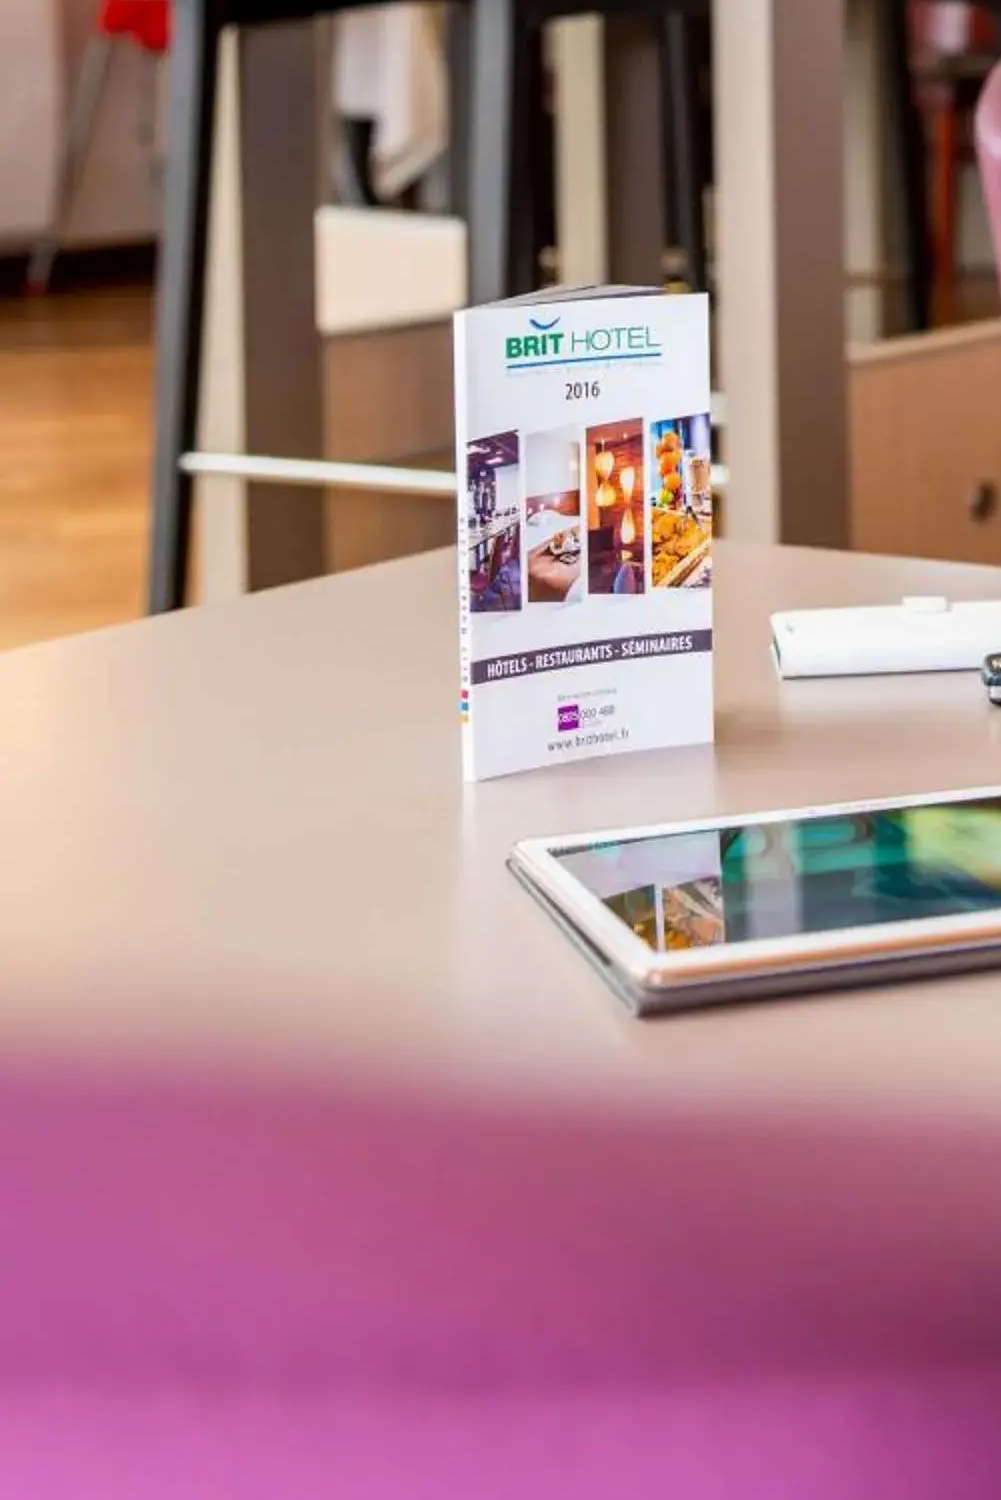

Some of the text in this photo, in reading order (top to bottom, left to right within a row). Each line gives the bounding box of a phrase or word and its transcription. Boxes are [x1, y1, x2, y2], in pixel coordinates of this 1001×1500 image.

[506, 326, 661, 358] BRIT HOTEL
[565, 381, 600, 400] 2016
[488, 657, 527, 678] HÔTELS
[536, 644, 612, 668] RESTAURANTS
